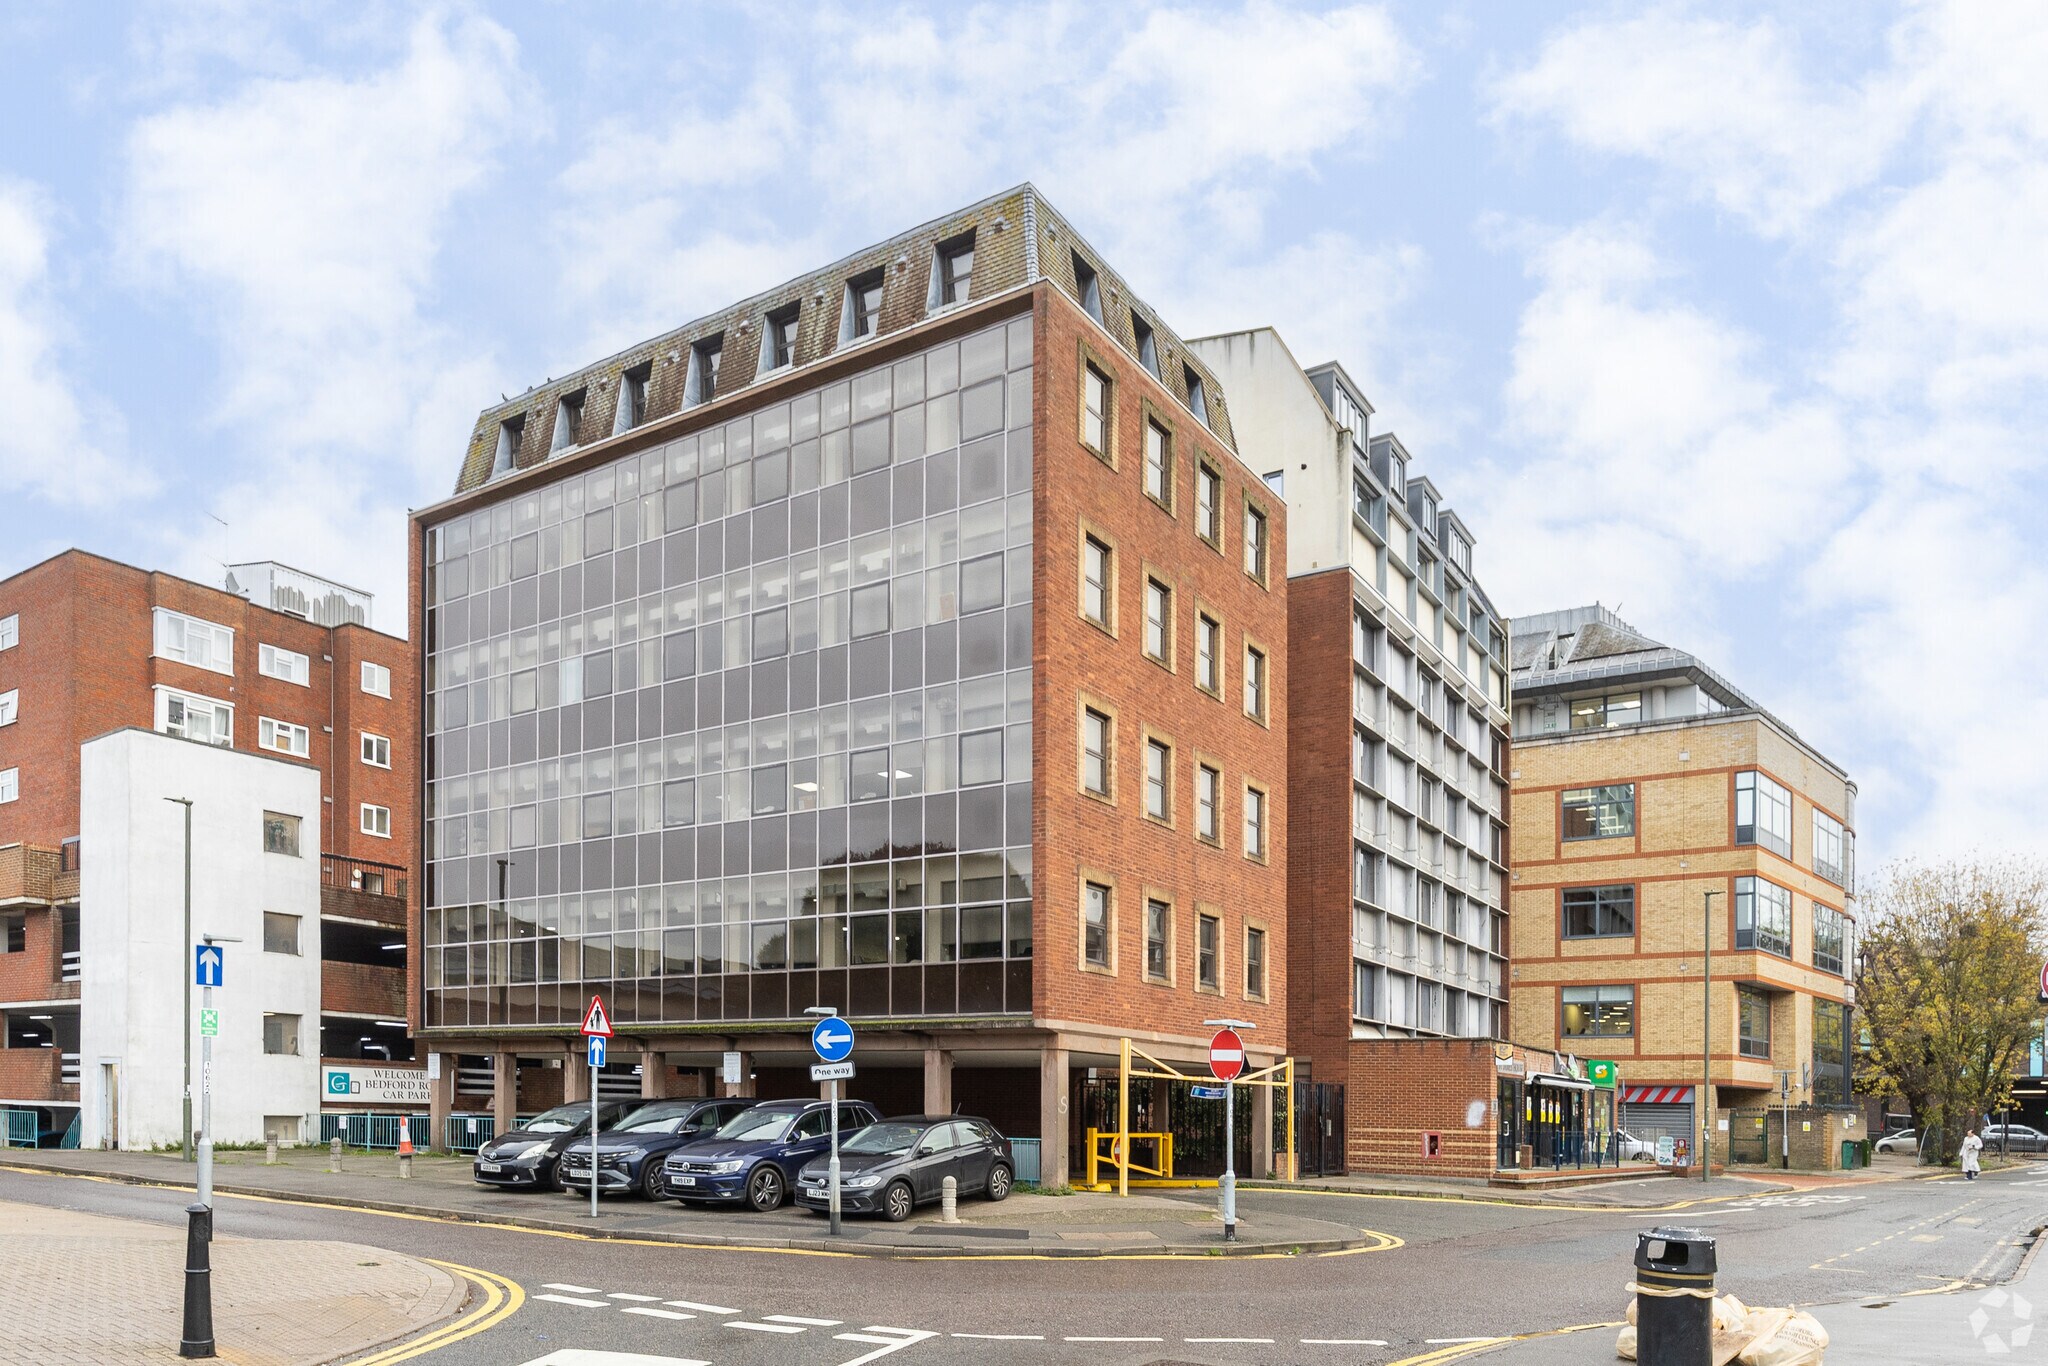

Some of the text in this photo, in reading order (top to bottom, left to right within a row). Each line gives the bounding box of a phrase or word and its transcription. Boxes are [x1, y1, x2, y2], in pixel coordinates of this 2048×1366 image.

[374, 1069, 426, 1080] WELCOME
[834, 1067, 850, 1075] way
[365, 1080, 415, 1090] BEDFORD
[383, 1091, 405, 1099] CAR
[683, 1178, 693, 1186] EXP
